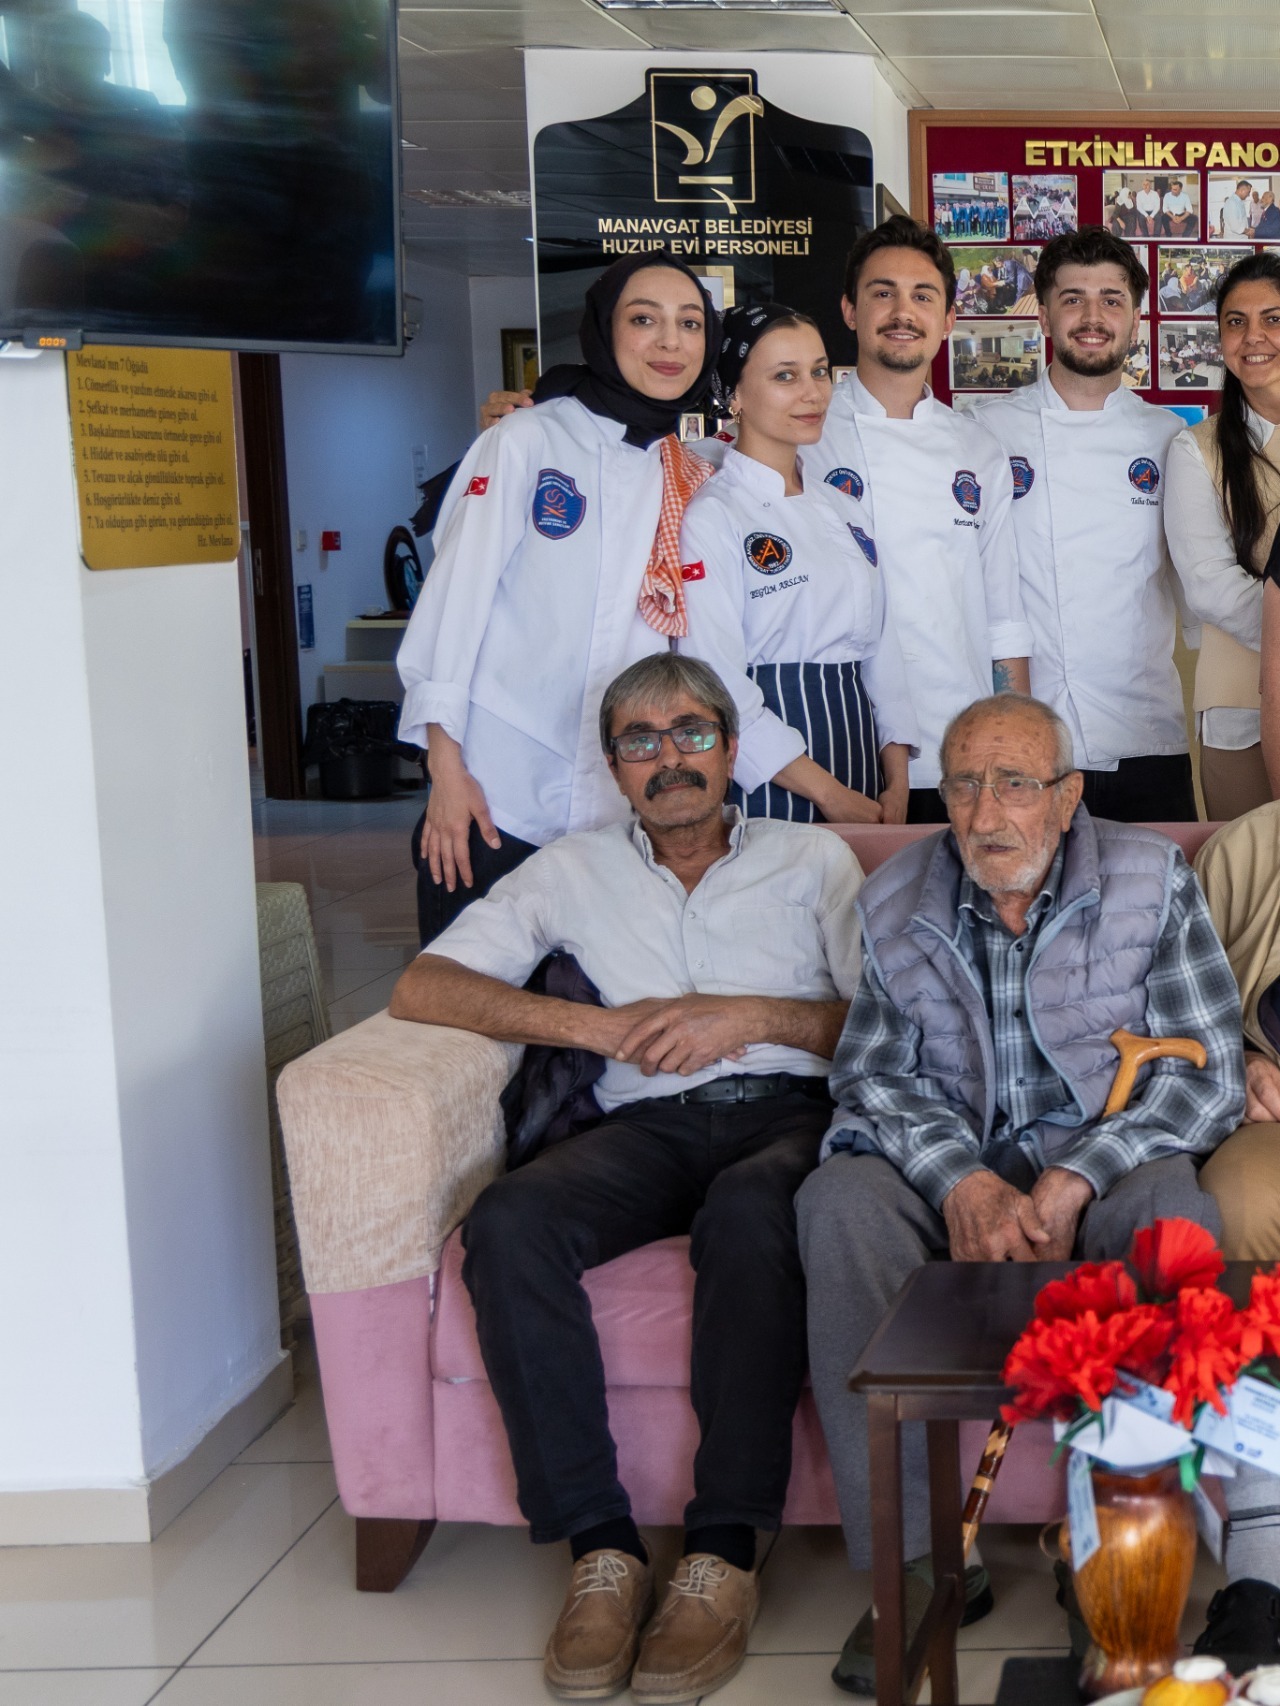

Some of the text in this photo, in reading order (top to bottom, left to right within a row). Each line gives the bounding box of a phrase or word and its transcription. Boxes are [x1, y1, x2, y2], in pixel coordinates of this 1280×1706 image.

[1025, 134, 1178, 167] ETKİNLİK
[598, 217, 813, 235] MANAVGAT BELEDİYESİ
[602, 237, 809, 255] HUZUR EVİ PERSONELİ
[779, 574, 809, 591] ARSLAN
